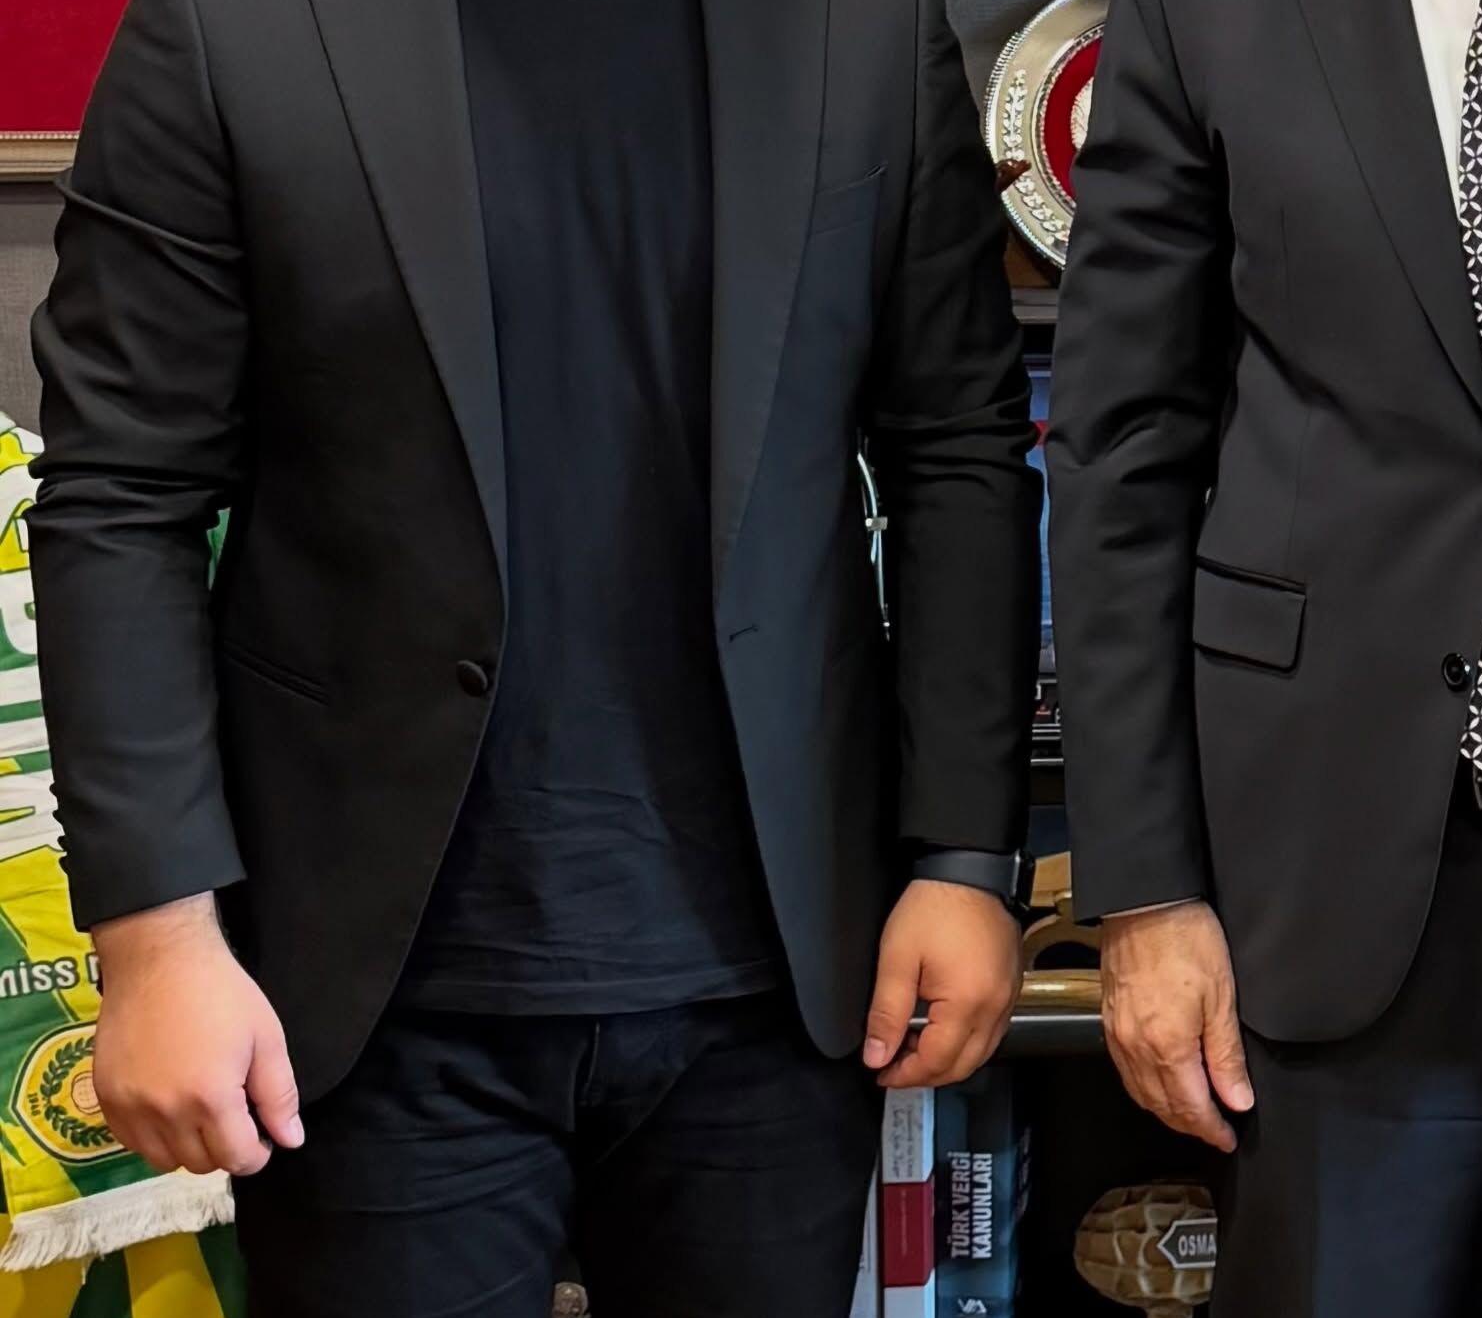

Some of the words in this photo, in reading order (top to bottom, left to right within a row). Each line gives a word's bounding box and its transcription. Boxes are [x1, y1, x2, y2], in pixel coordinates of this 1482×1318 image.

[947, 1151, 971, 1205] VERGİ
[971, 1152, 993, 1259] KANUNLARI
[947, 1209, 970, 1259] TÜRK
